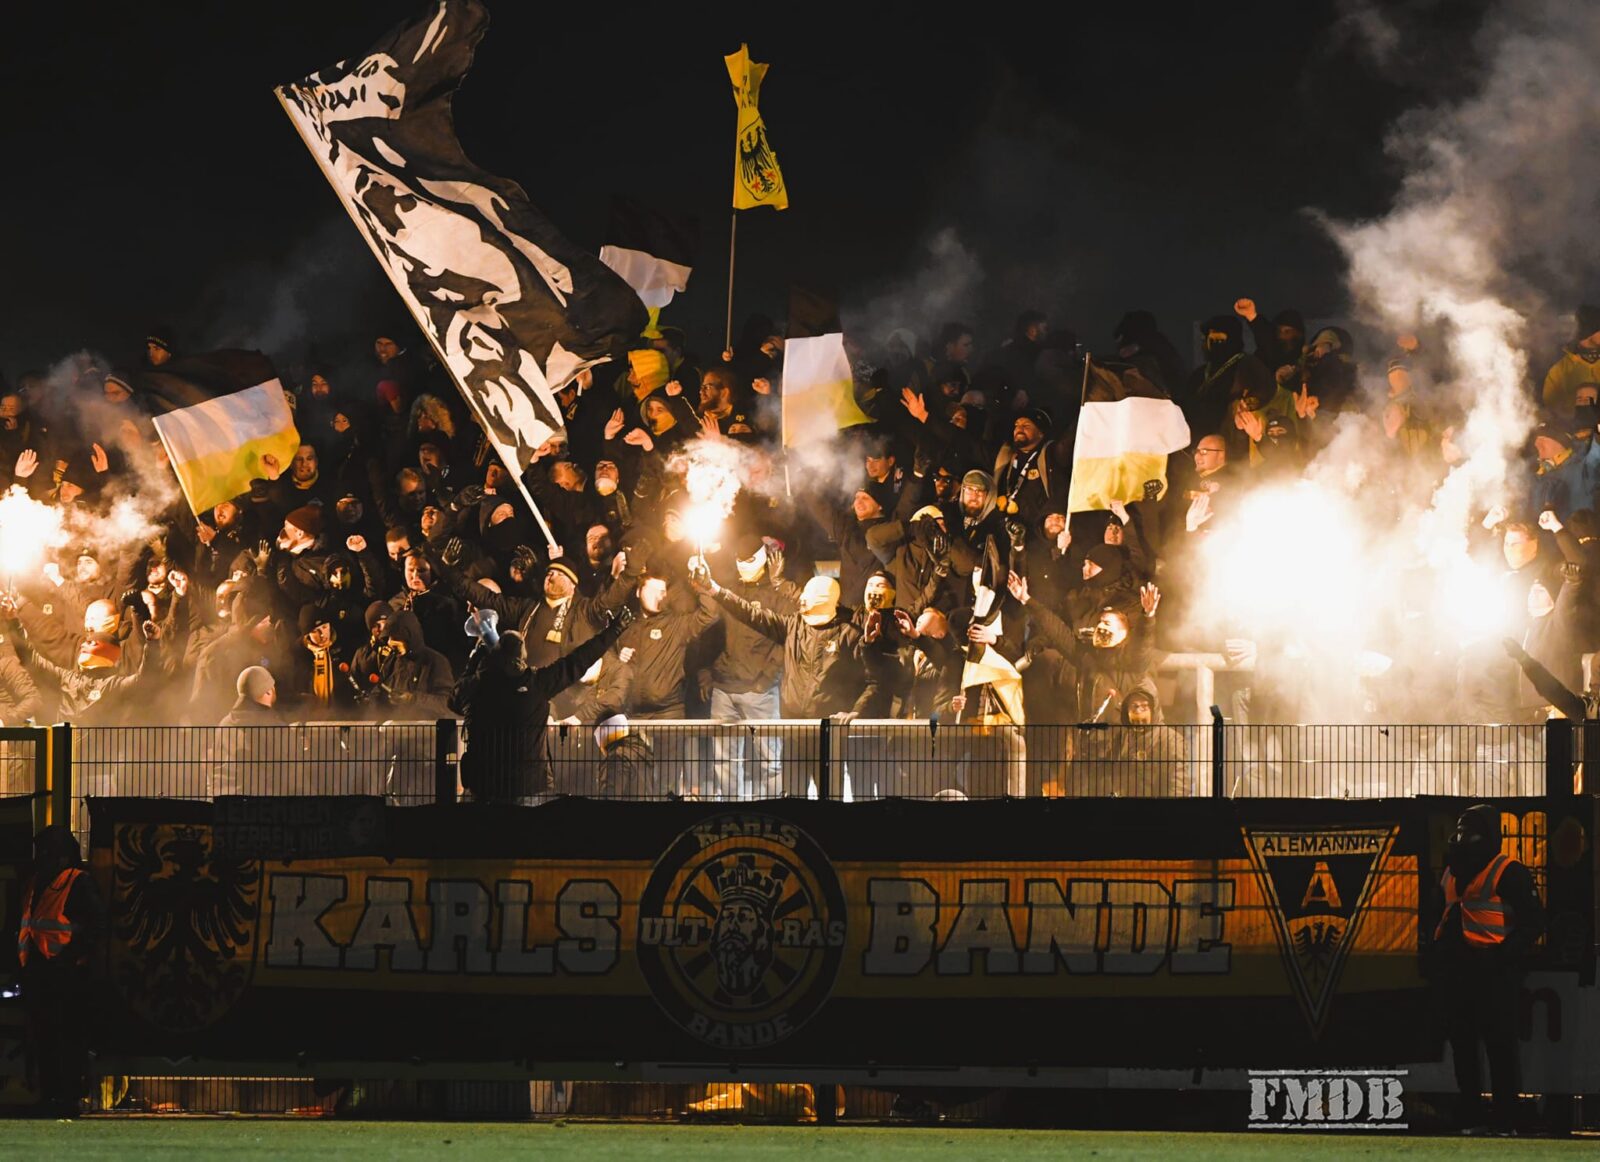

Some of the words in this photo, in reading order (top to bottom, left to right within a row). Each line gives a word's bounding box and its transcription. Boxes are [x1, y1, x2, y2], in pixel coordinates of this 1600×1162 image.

[692, 815, 799, 848] KARLS
[1262, 836, 1380, 853] ALEMANNIA
[1301, 861, 1342, 908] A
[267, 875, 622, 976] KARLS
[862, 877, 1234, 976] BANDE
[686, 1012, 794, 1046] BANDE
